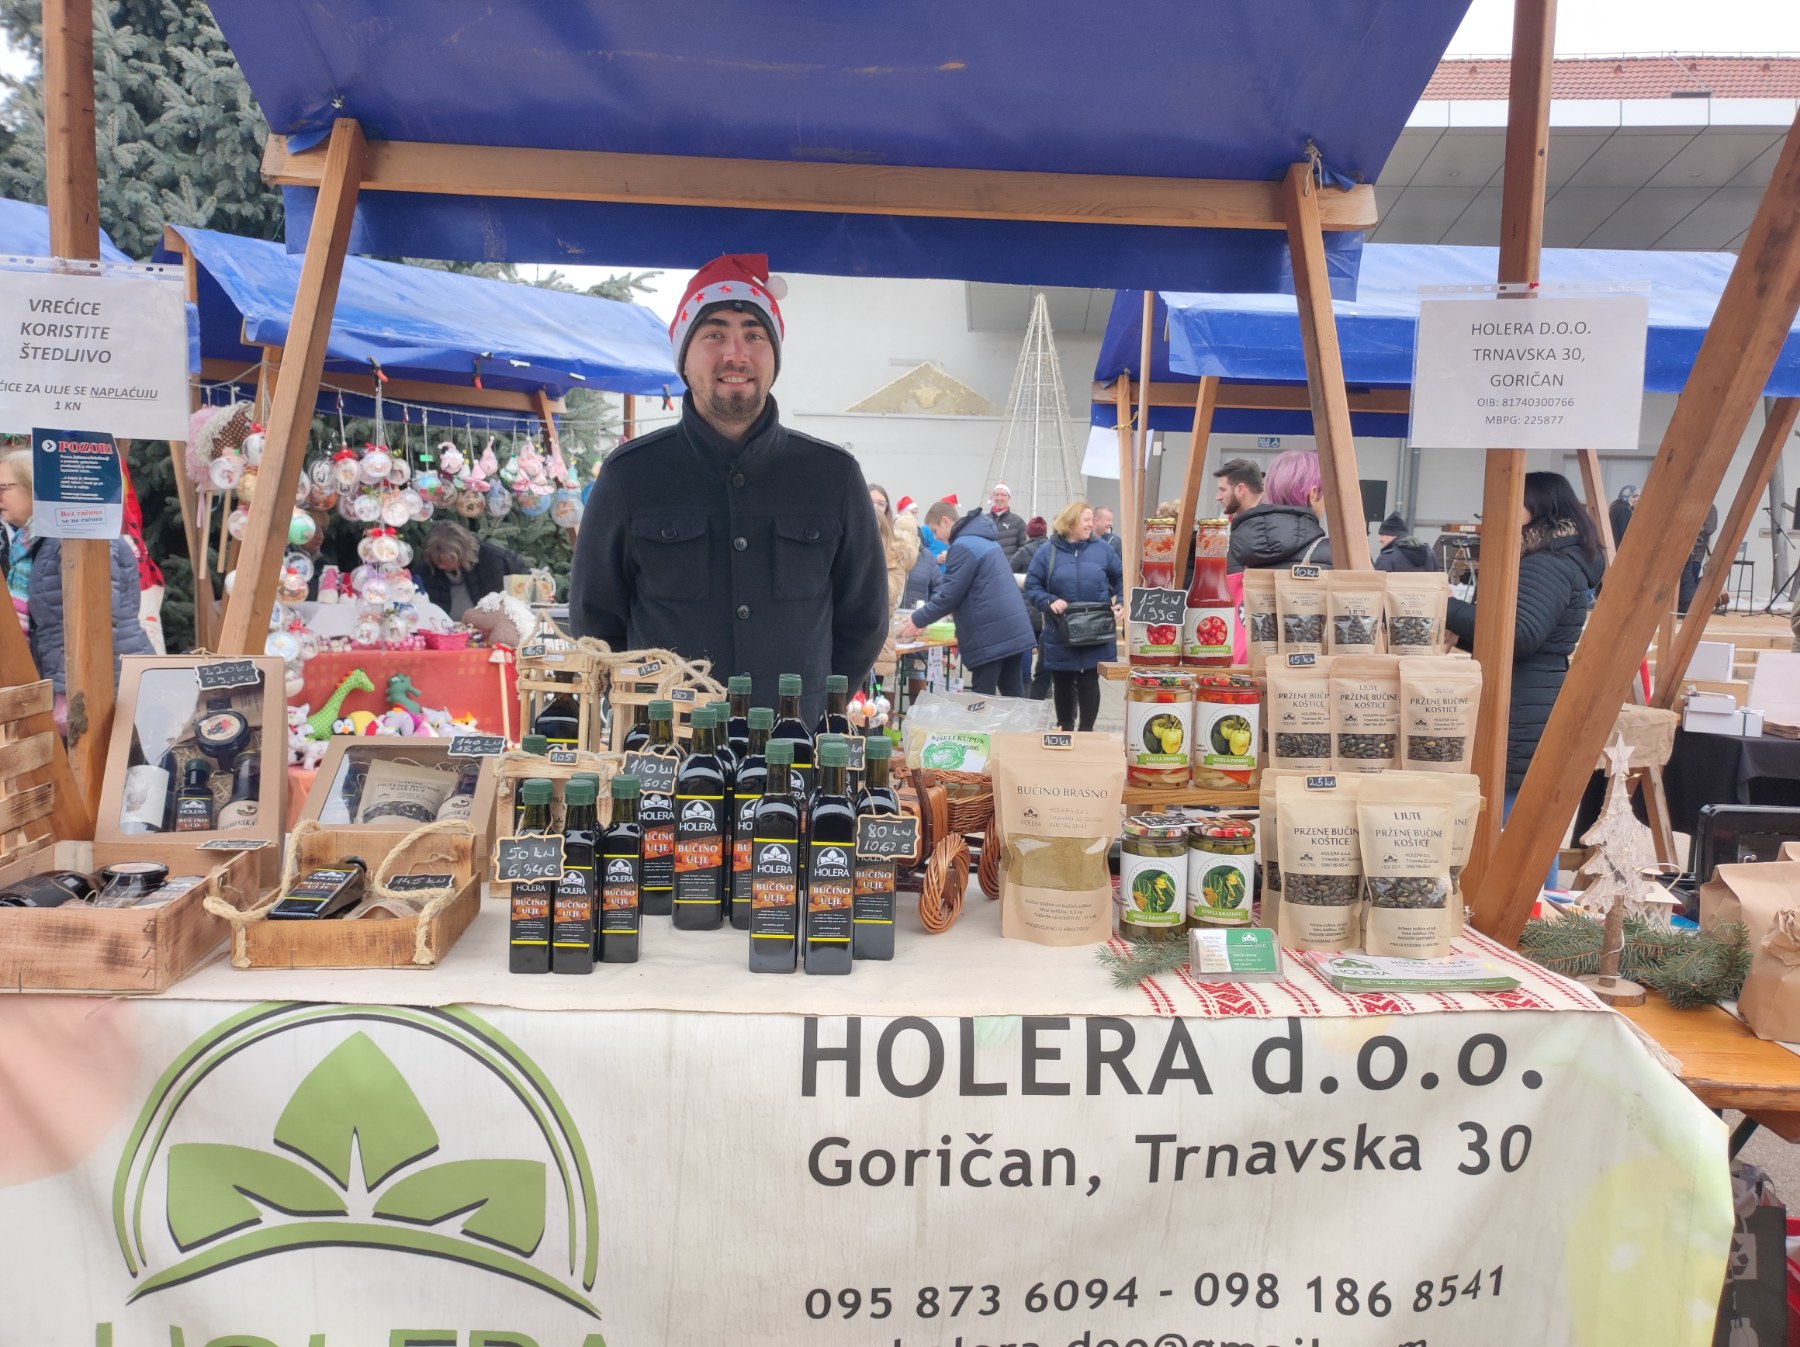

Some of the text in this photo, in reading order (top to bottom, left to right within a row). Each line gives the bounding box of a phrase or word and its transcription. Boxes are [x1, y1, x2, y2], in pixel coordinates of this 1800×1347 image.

[29, 298, 102, 316] VREĆICE
[20, 322, 110, 340] KORISTITE
[1471, 321, 1591, 336] HOLERA D.O.O.
[19, 342, 111, 363] ŠTEDLJIVO
[1473, 347, 1585, 363] TRNAVSKA 30,
[1490, 371, 1564, 387] GORIČAN
[25, 383, 41, 393] ZA
[44, 384, 70, 395] ULJE
[73, 386, 88, 396] SE
[90, 386, 159, 399] NAPLAĆUJU
[54, 400, 82, 411] 1 KN
[1477, 397, 1575, 407] OIB: 81740300766
[1485, 415, 1563, 425] MBPG: 225877
[1017, 784, 1108, 799] BUČINO BRAŠNO
[638, 811, 675, 821] HOLERA
[679, 822, 717, 832] HOLERA
[1294, 825, 1360, 836] PRŽENE BUČIN
[1375, 827, 1443, 838] PRŽENE BUČINE
[645, 831, 675, 841] UČINO
[1311, 835, 1350, 846] KOŠTICE
[678, 842, 718, 853] BUČINO
[1394, 837, 1430, 847] KOŠTICE
[646, 843, 669, 854] ULJE
[686, 856, 709, 865] ULJE
[758, 864, 793, 874] HOLERA
[814, 867, 850, 878] HOLERA
[855, 868, 892, 879] BUČINO
[605, 875, 635, 883] HOLERA
[863, 879, 884, 889] ULJE
[516, 883, 546, 892] HOLERA
[557, 886, 587, 895] HOLERA
[604, 886, 635, 896] BUČINO
[756, 880, 794, 892] BUČINO
[813, 884, 850, 895] BUČINO
[515, 896, 547, 906] BUČINO
[611, 897, 629, 905] ULJE
[763, 892, 785, 902] ULJE
[820, 895, 842, 906] ULJE
[556, 899, 588, 909] BUČINO
[521, 906, 540, 915] ULJE
[562, 909, 582, 919] ULJE
[1332, 968, 1393, 977] HOLERA
[801, 1016, 1544, 1098] HOLERA d.o.o.
[808, 1121, 1533, 1198] Goričan, Trnavska 30
[805, 1286, 894, 1322] 095
[915, 1284, 1002, 1319] 873
[1024, 1276, 1140, 1314] 6094
[1194, 1271, 1280, 1310] 098
[1306, 1274, 1393, 1319] 186
[1411, 1265, 1505, 1314] 8541
